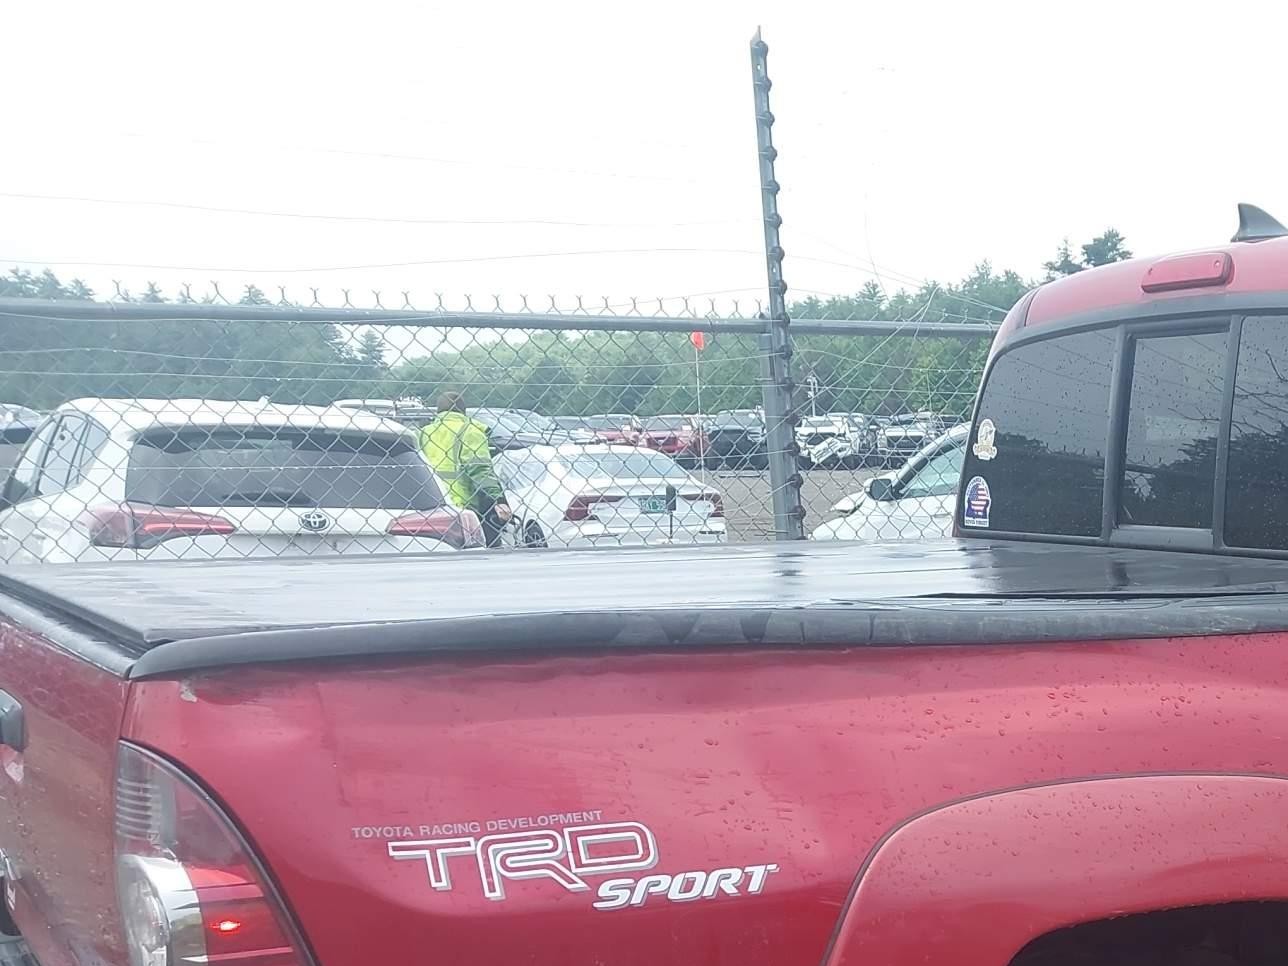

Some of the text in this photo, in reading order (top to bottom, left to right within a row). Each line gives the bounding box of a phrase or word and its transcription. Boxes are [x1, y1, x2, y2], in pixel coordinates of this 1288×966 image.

[351, 810, 603, 839] TOYOTA RACING DEVELOPMENT
[387, 820, 660, 900] TRD
[592, 863, 780, 910] SPORT
